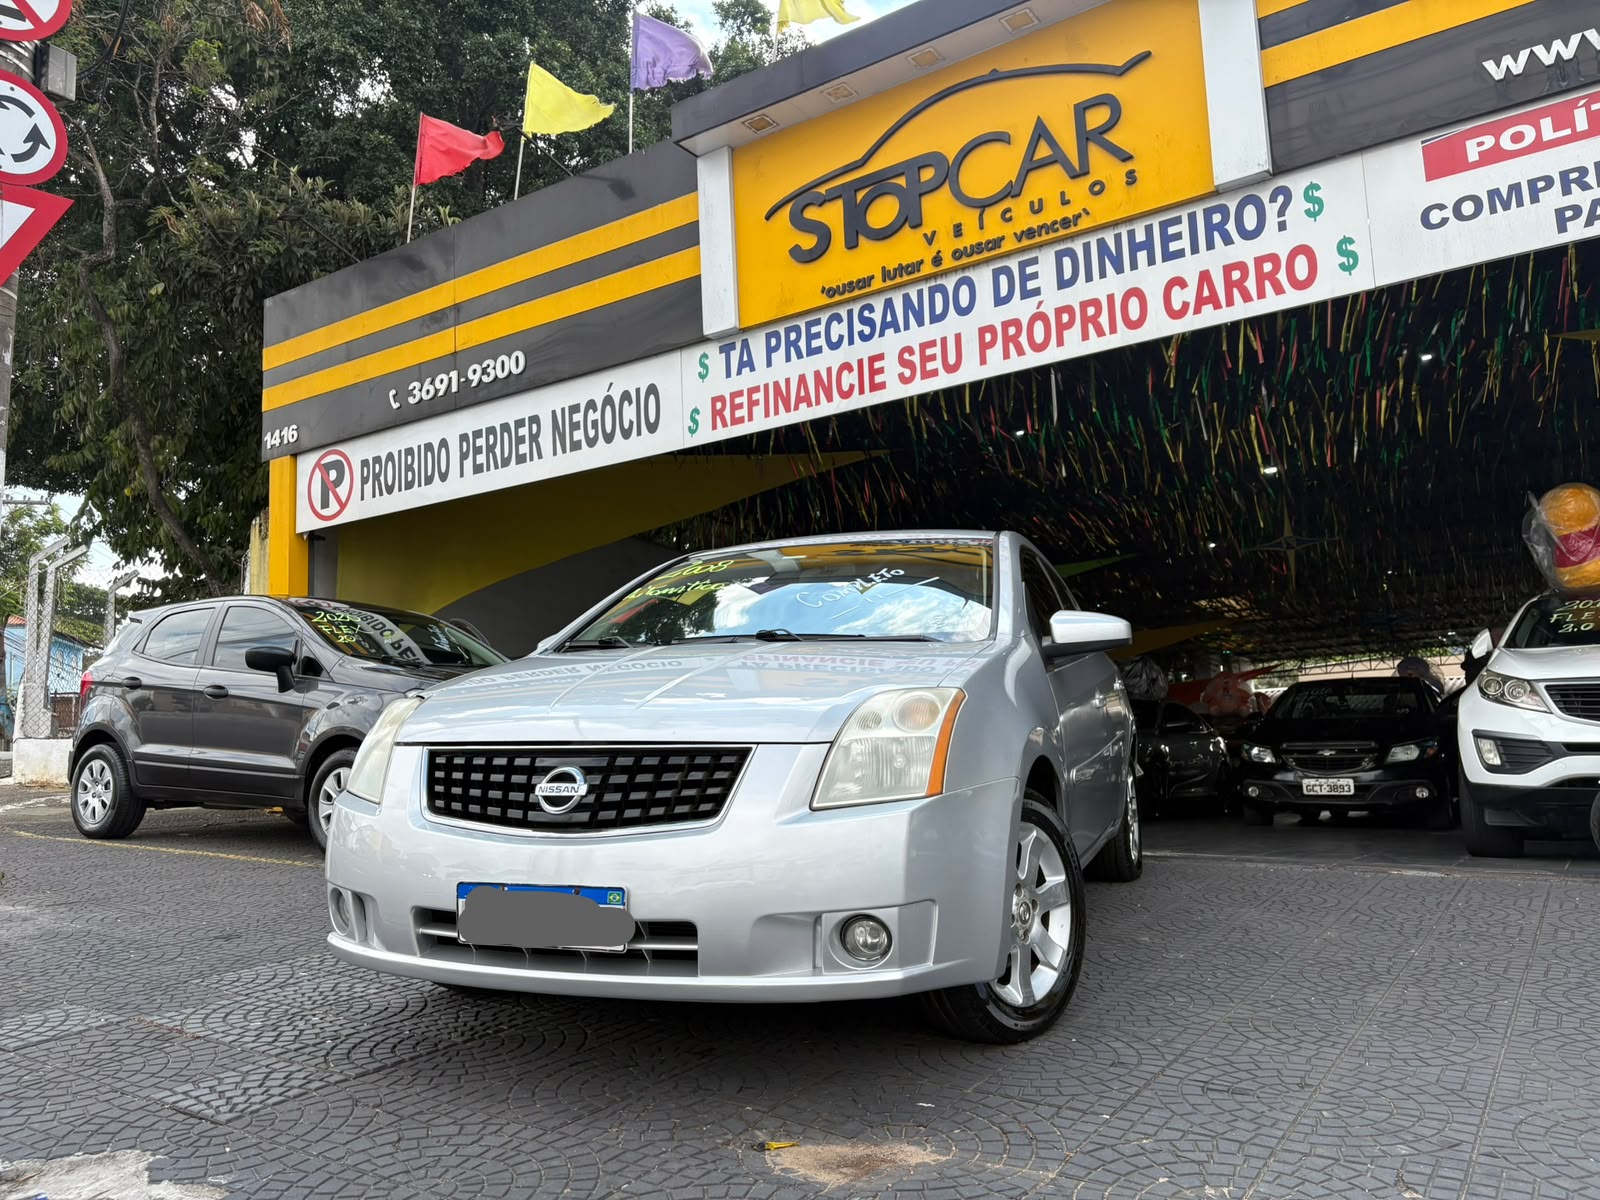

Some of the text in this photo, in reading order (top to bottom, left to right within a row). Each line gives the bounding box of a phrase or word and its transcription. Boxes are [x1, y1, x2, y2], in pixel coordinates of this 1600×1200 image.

[923, 169, 1138, 246] VEÍCULOS
[1420, 160, 1600, 231] COMPR
[718, 342, 756, 380] TA
[765, 275, 977, 370] PRECISANDO
[992, 257, 1041, 308] DE
[1055, 184, 1293, 289] DINHEIRO?
[881, 259, 924, 282] lutar
[931, 249, 943, 267] é
[951, 235, 1006, 261] ousar
[710, 355, 887, 432] REFINANCIE
[897, 336, 963, 386] SEU
[978, 286, 1148, 366] PRÓPRIO
[1162, 243, 1319, 320] CARRO
[407, 350, 526, 405] 3691-9300
[264, 424, 298, 449] 1416
[360, 381, 661, 501] PROIBIDO PERDER NEGÓCIO
[1549, 612, 1600, 623] FLE
[538, 785, 580, 794] NISSAN
